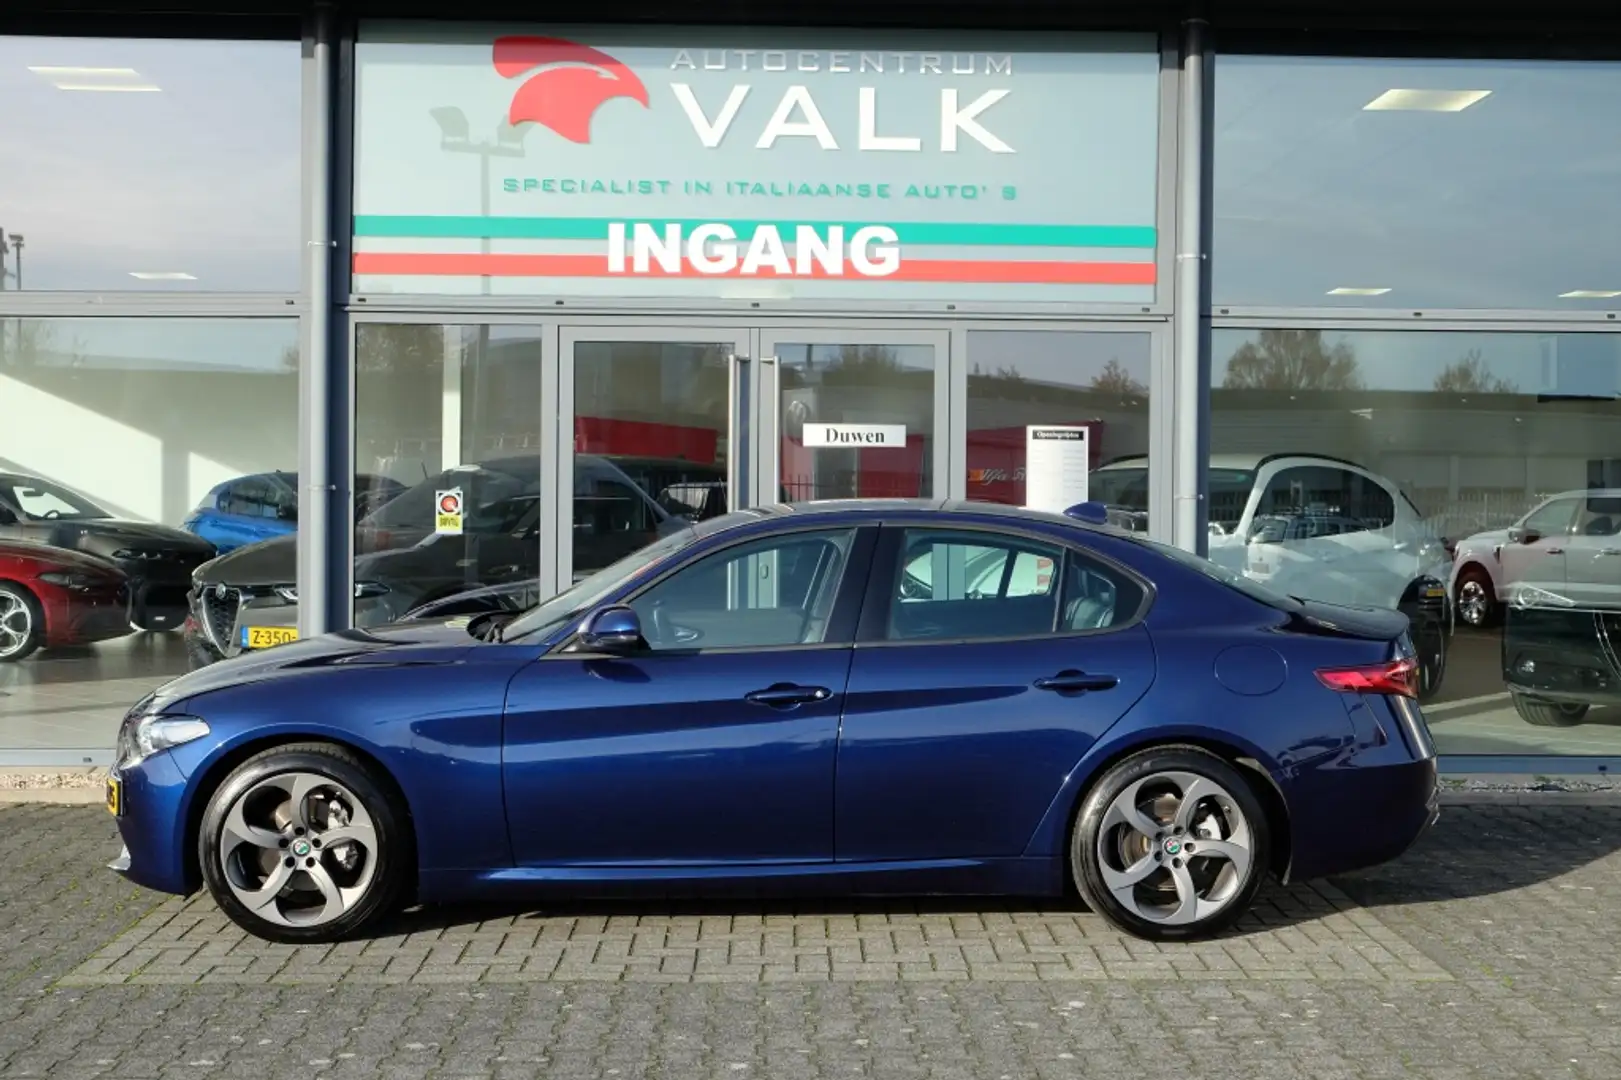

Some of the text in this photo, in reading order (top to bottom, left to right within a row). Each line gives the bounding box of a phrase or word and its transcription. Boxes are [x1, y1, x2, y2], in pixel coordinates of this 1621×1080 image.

[669, 49, 1012, 75] AUTOCENTRUM
[669, 82, 1018, 154] VALK
[503, 178, 671, 195] SPECIALIST
[684, 181, 713, 195] IN
[726, 181, 892, 199] ITALIAANSE
[607, 222, 900, 277] INGANG
[825, 427, 886, 444] Duwen
[252, 630, 297, 645] Z-350-
